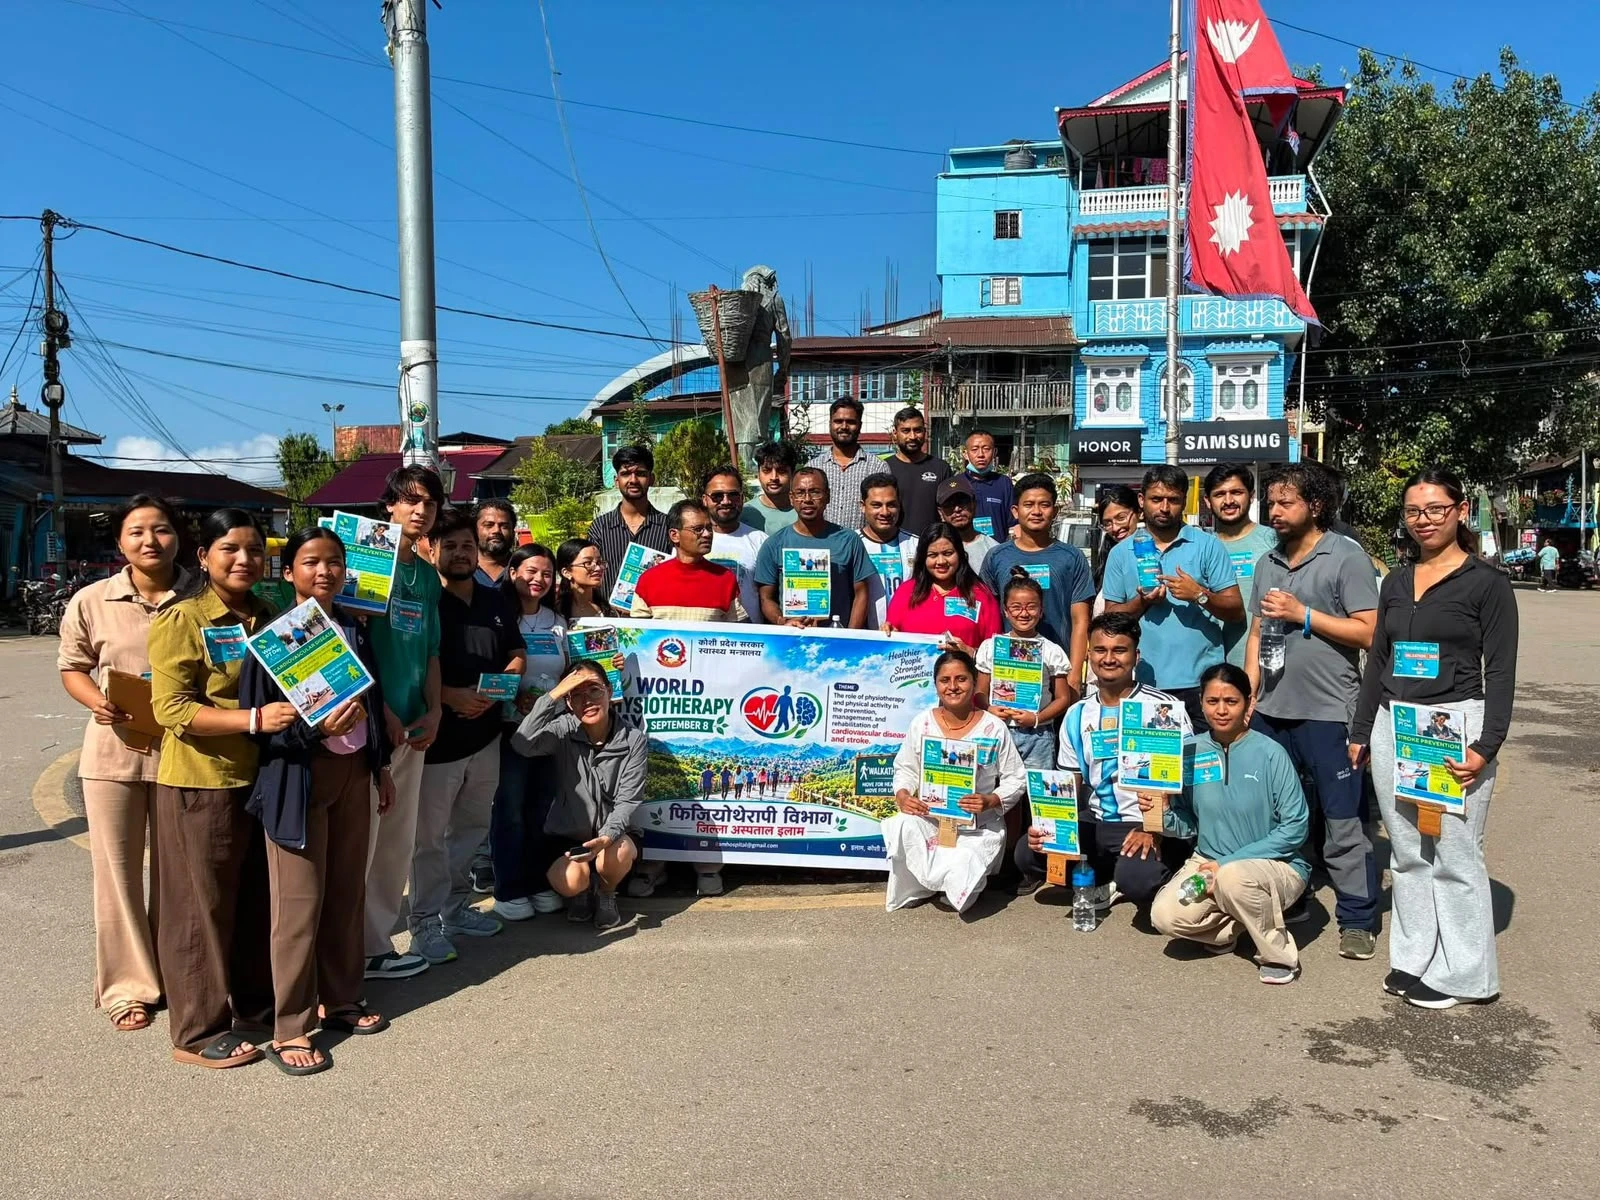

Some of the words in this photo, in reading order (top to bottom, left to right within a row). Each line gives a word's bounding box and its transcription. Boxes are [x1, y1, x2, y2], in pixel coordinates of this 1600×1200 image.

[1078, 441, 1131, 452] HONOR
[1184, 433, 1281, 450] SAMSUNG
[357, 547, 393, 558] PREVENTION
[698, 637, 717, 647] कोशी
[720, 639, 737, 648] प्रदेश
[272, 642, 316, 673] CARDIOVASCULAR
[888, 649, 920, 661] Healthier
[900, 657, 922, 666] People
[894, 665, 924, 674] Stronger
[890, 670, 933, 683] Communities
[636, 677, 704, 695] WORLD
[865, 695, 905, 703] physiotherapy
[615, 696, 734, 715] YSIOTHERAPY
[651, 721, 700, 730] SEPTEMBER
[703, 722, 709, 730] 8
[831, 728, 881, 737] cardiovascular
[1397, 734, 1419, 743] STROKE
[1421, 738, 1460, 749] PREVENTION
[868, 767, 895, 776] WALKAT
[669, 803, 778, 824] फिजियोथेरापी
[784, 805, 833, 826] विभाग
[696, 821, 728, 834] जिल्ला
[731, 823, 774, 836] अस्पताल
[777, 824, 805, 837] इलाम
